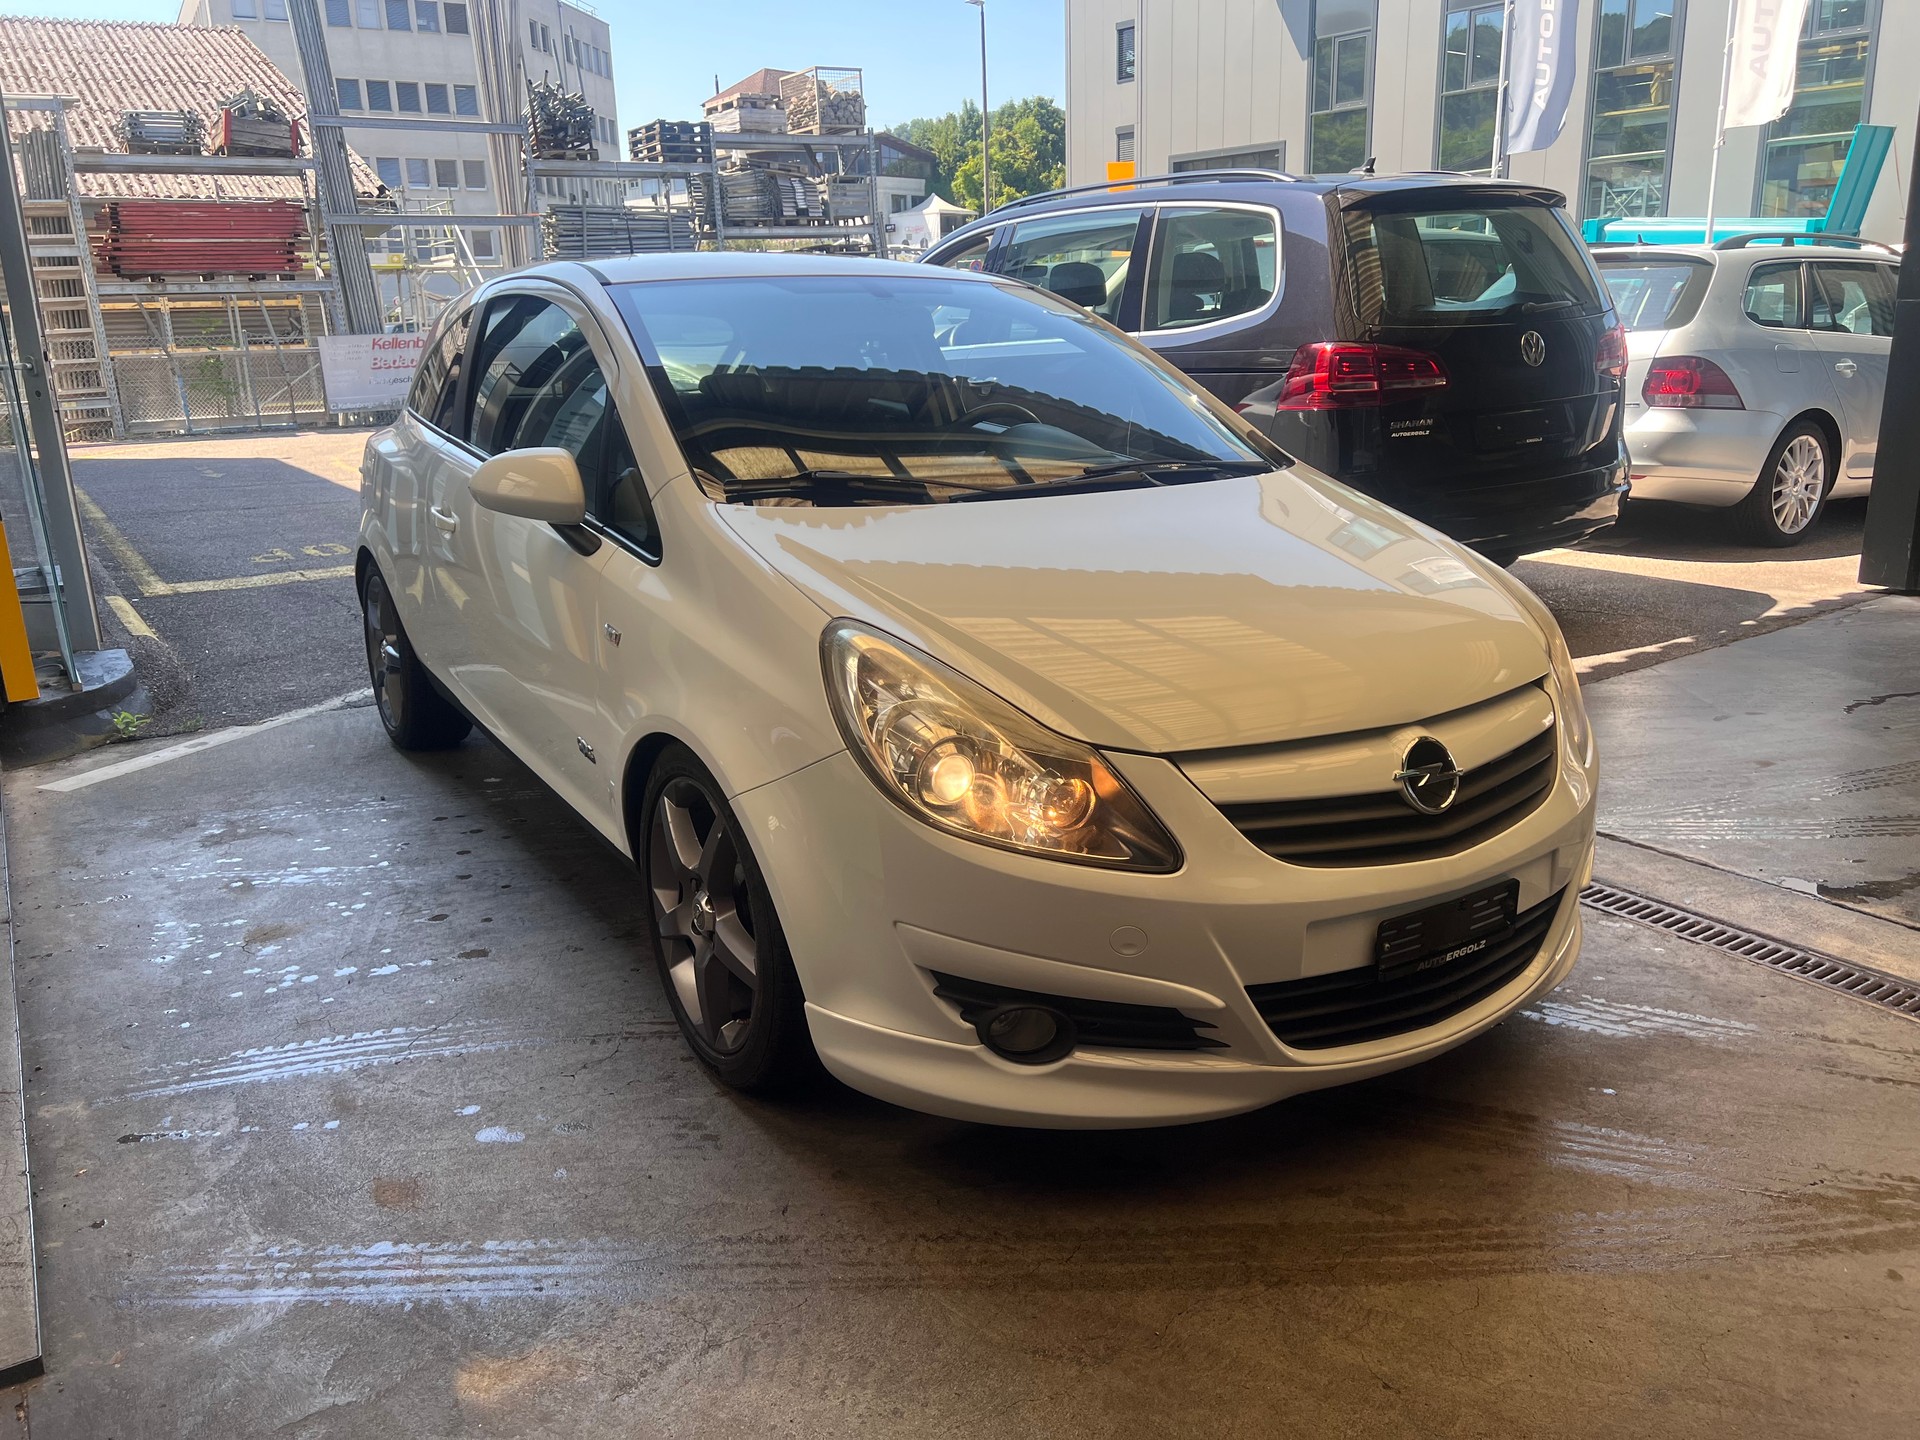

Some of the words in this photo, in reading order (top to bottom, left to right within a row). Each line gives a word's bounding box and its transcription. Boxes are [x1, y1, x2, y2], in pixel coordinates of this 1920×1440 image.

[371, 337, 425, 350] Kellenb
[1390, 418, 1434, 430] SHARAN
[1391, 430, 1430, 438] AUTOERGOLZ
[1417, 940, 1486, 971] AUTOERGOLZ
